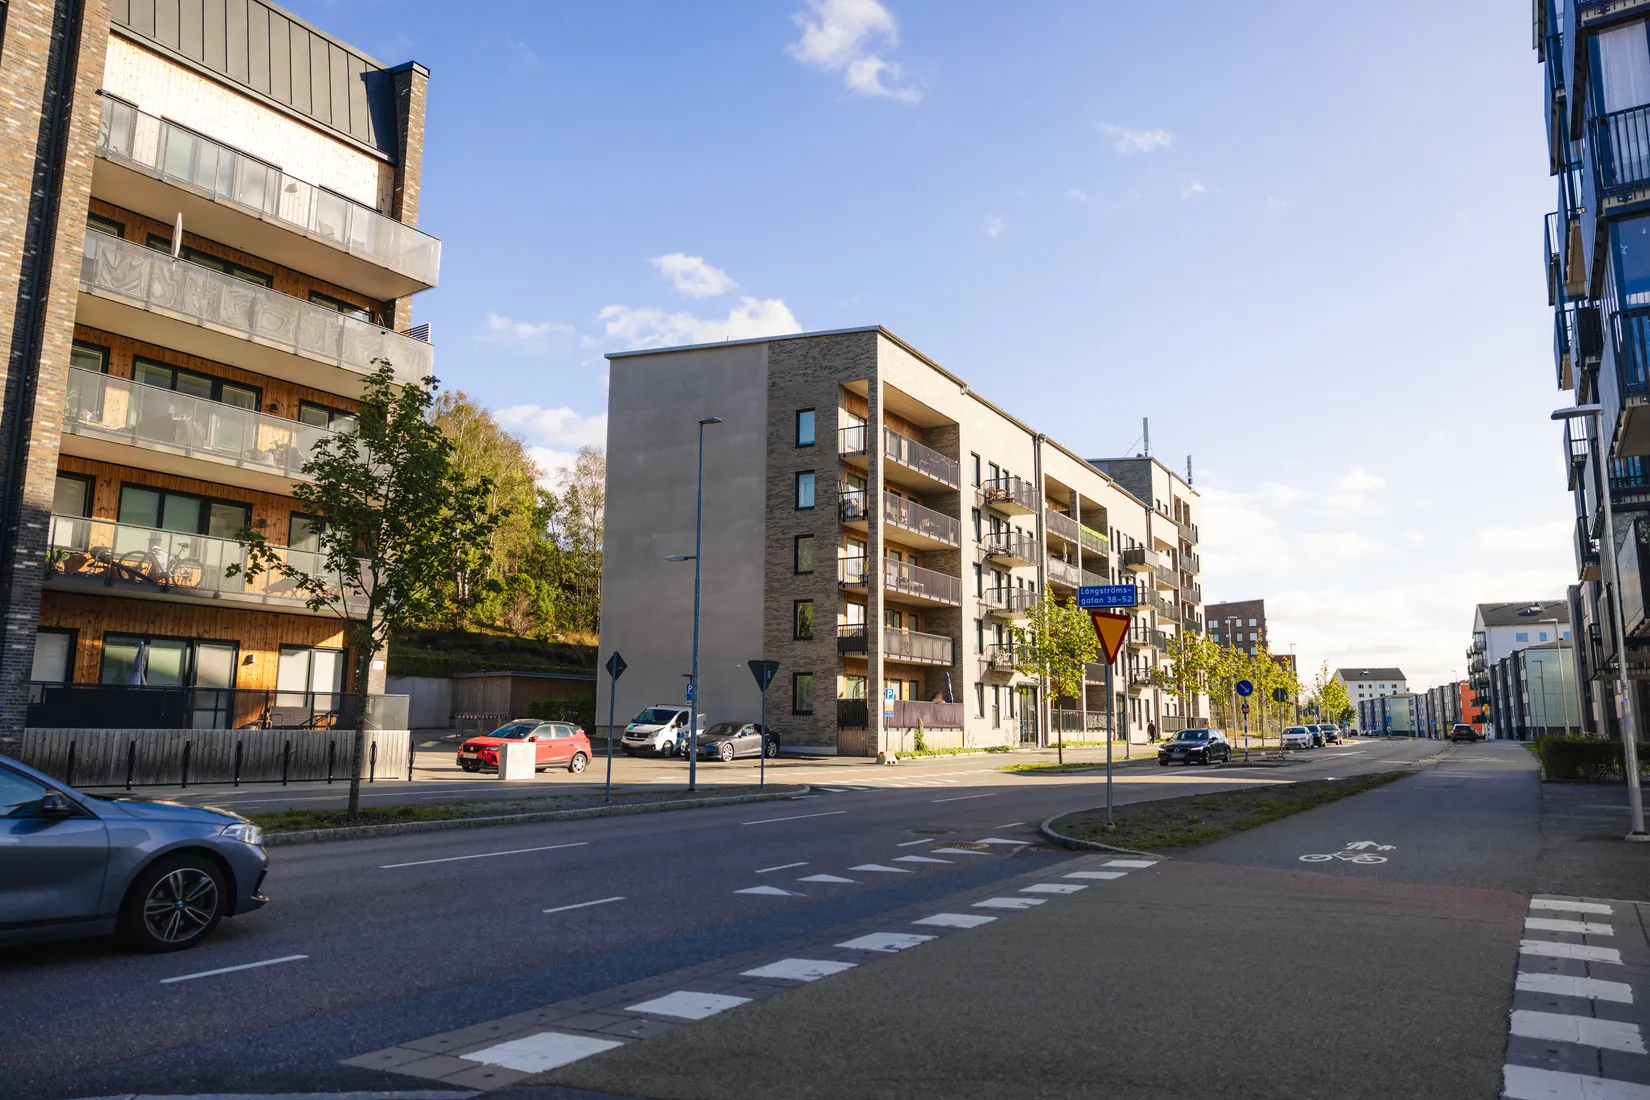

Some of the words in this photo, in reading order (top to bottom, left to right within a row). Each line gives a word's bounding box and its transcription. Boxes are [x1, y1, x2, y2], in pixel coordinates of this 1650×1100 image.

[1081, 586, 1132, 596] Långströms-
[1081, 597, 1104, 606] gatan
[1106, 595, 1133, 603] 38-52
